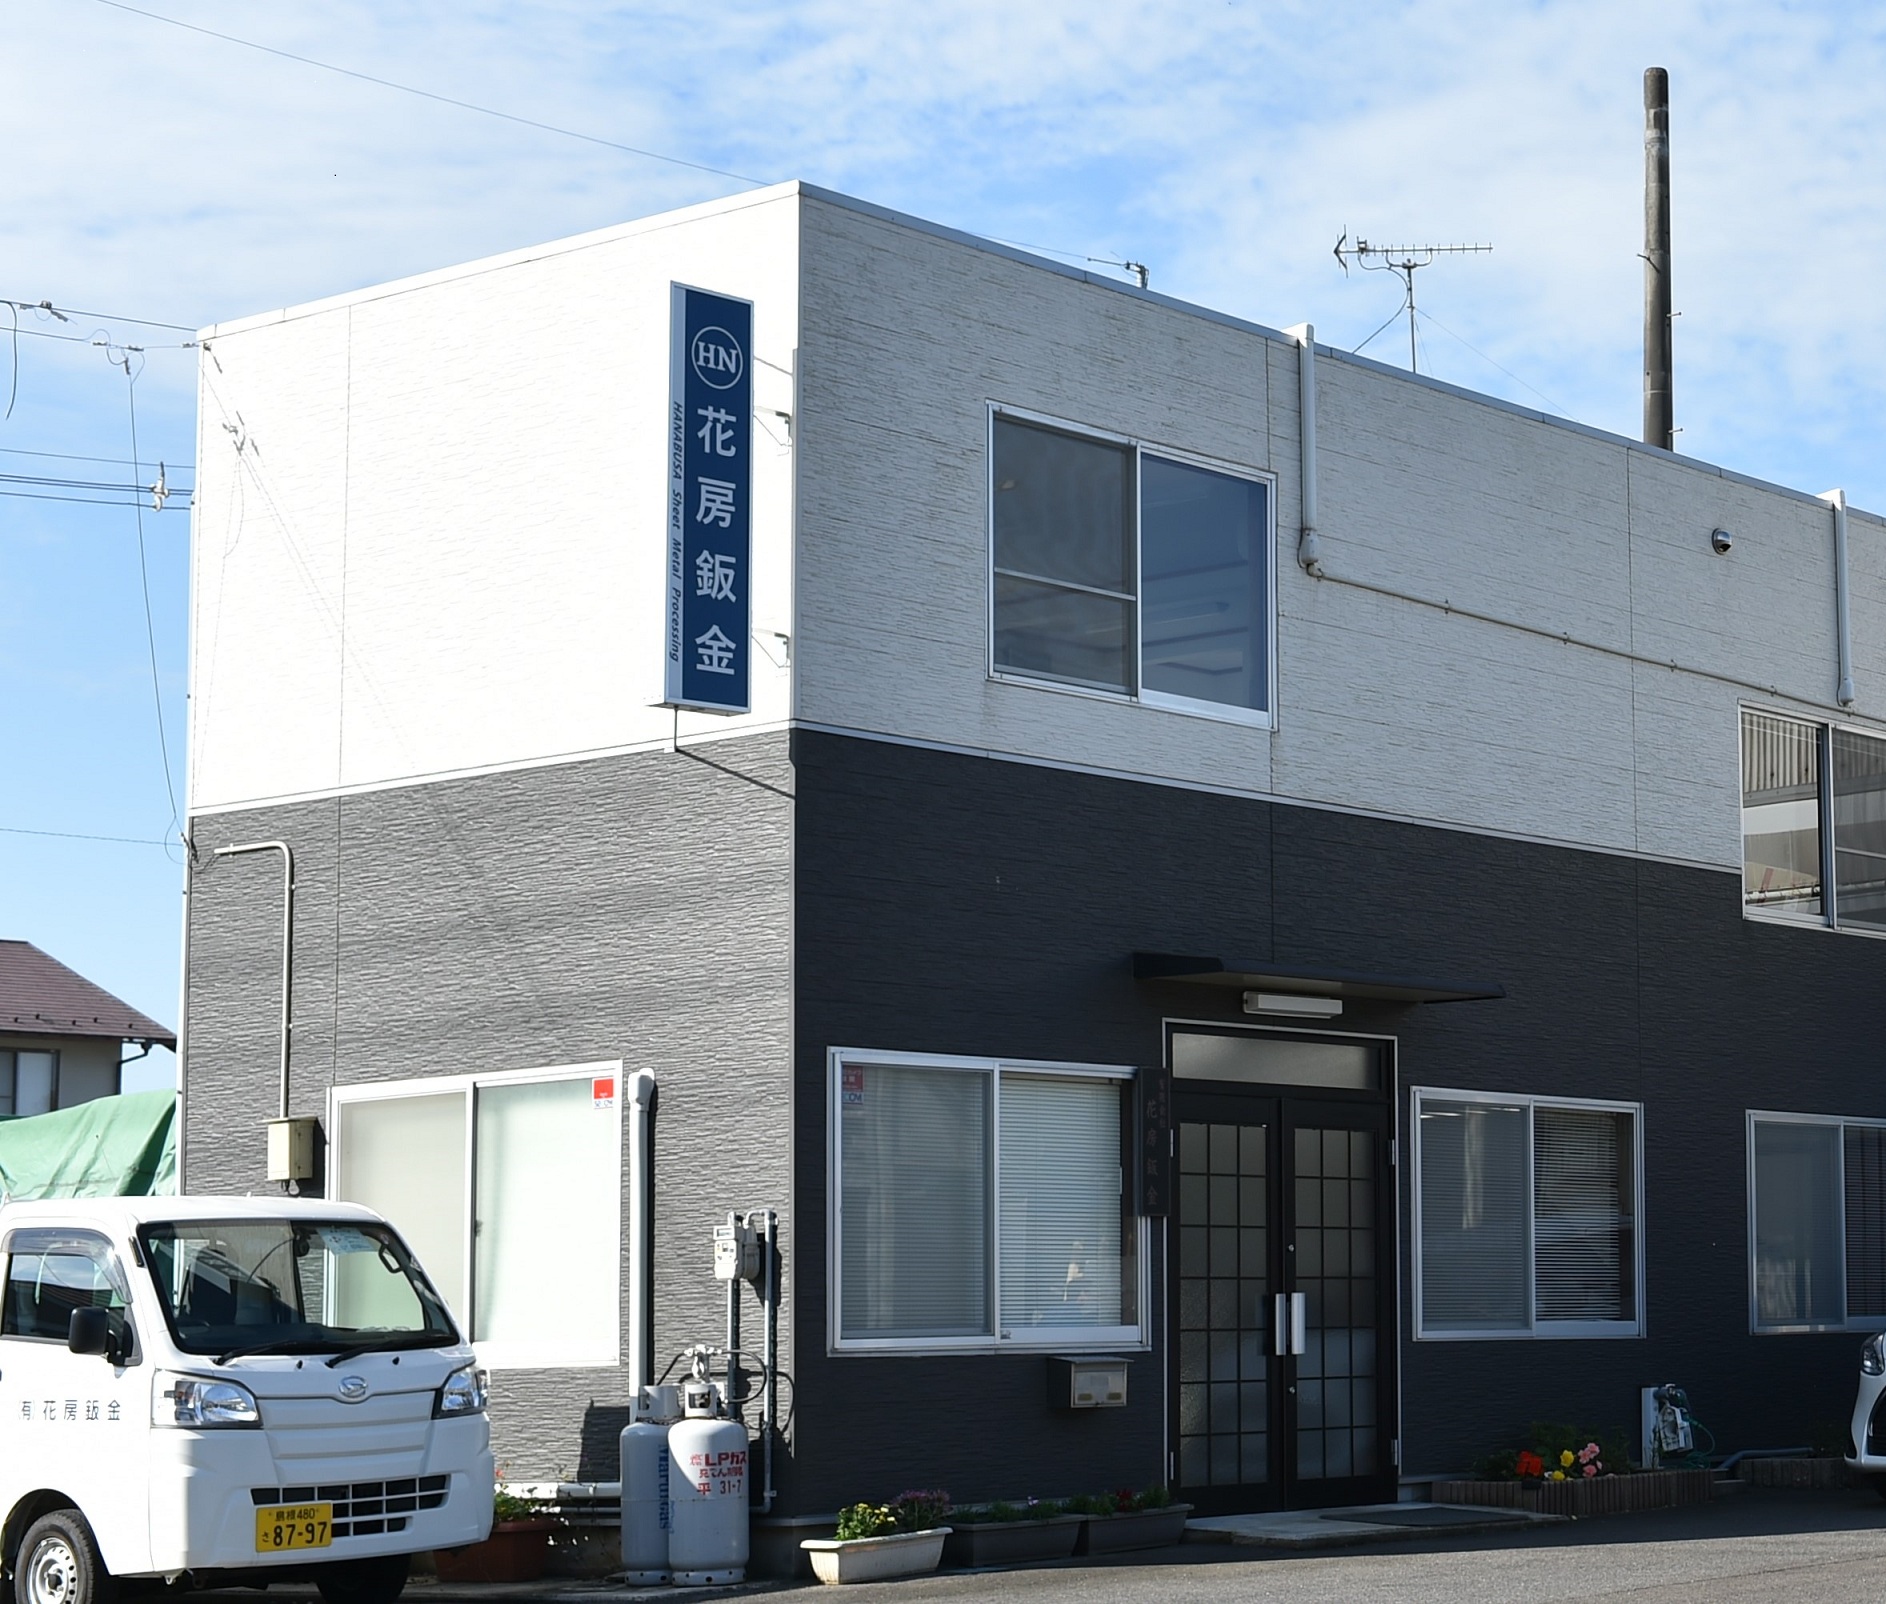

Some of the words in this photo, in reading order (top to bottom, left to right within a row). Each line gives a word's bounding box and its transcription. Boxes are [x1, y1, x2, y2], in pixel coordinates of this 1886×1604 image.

[696, 340, 738, 374] HN
[673, 400, 683, 480] HANABUSA
[672, 488, 682, 530] Sheet
[671, 537, 682, 580] Metal
[694, 404, 737, 676] 花房鈑金
[669, 586, 682, 663] Processing
[273, 1521, 327, 1547] 87-97
[275, 1505, 316, 1521] 島根480
